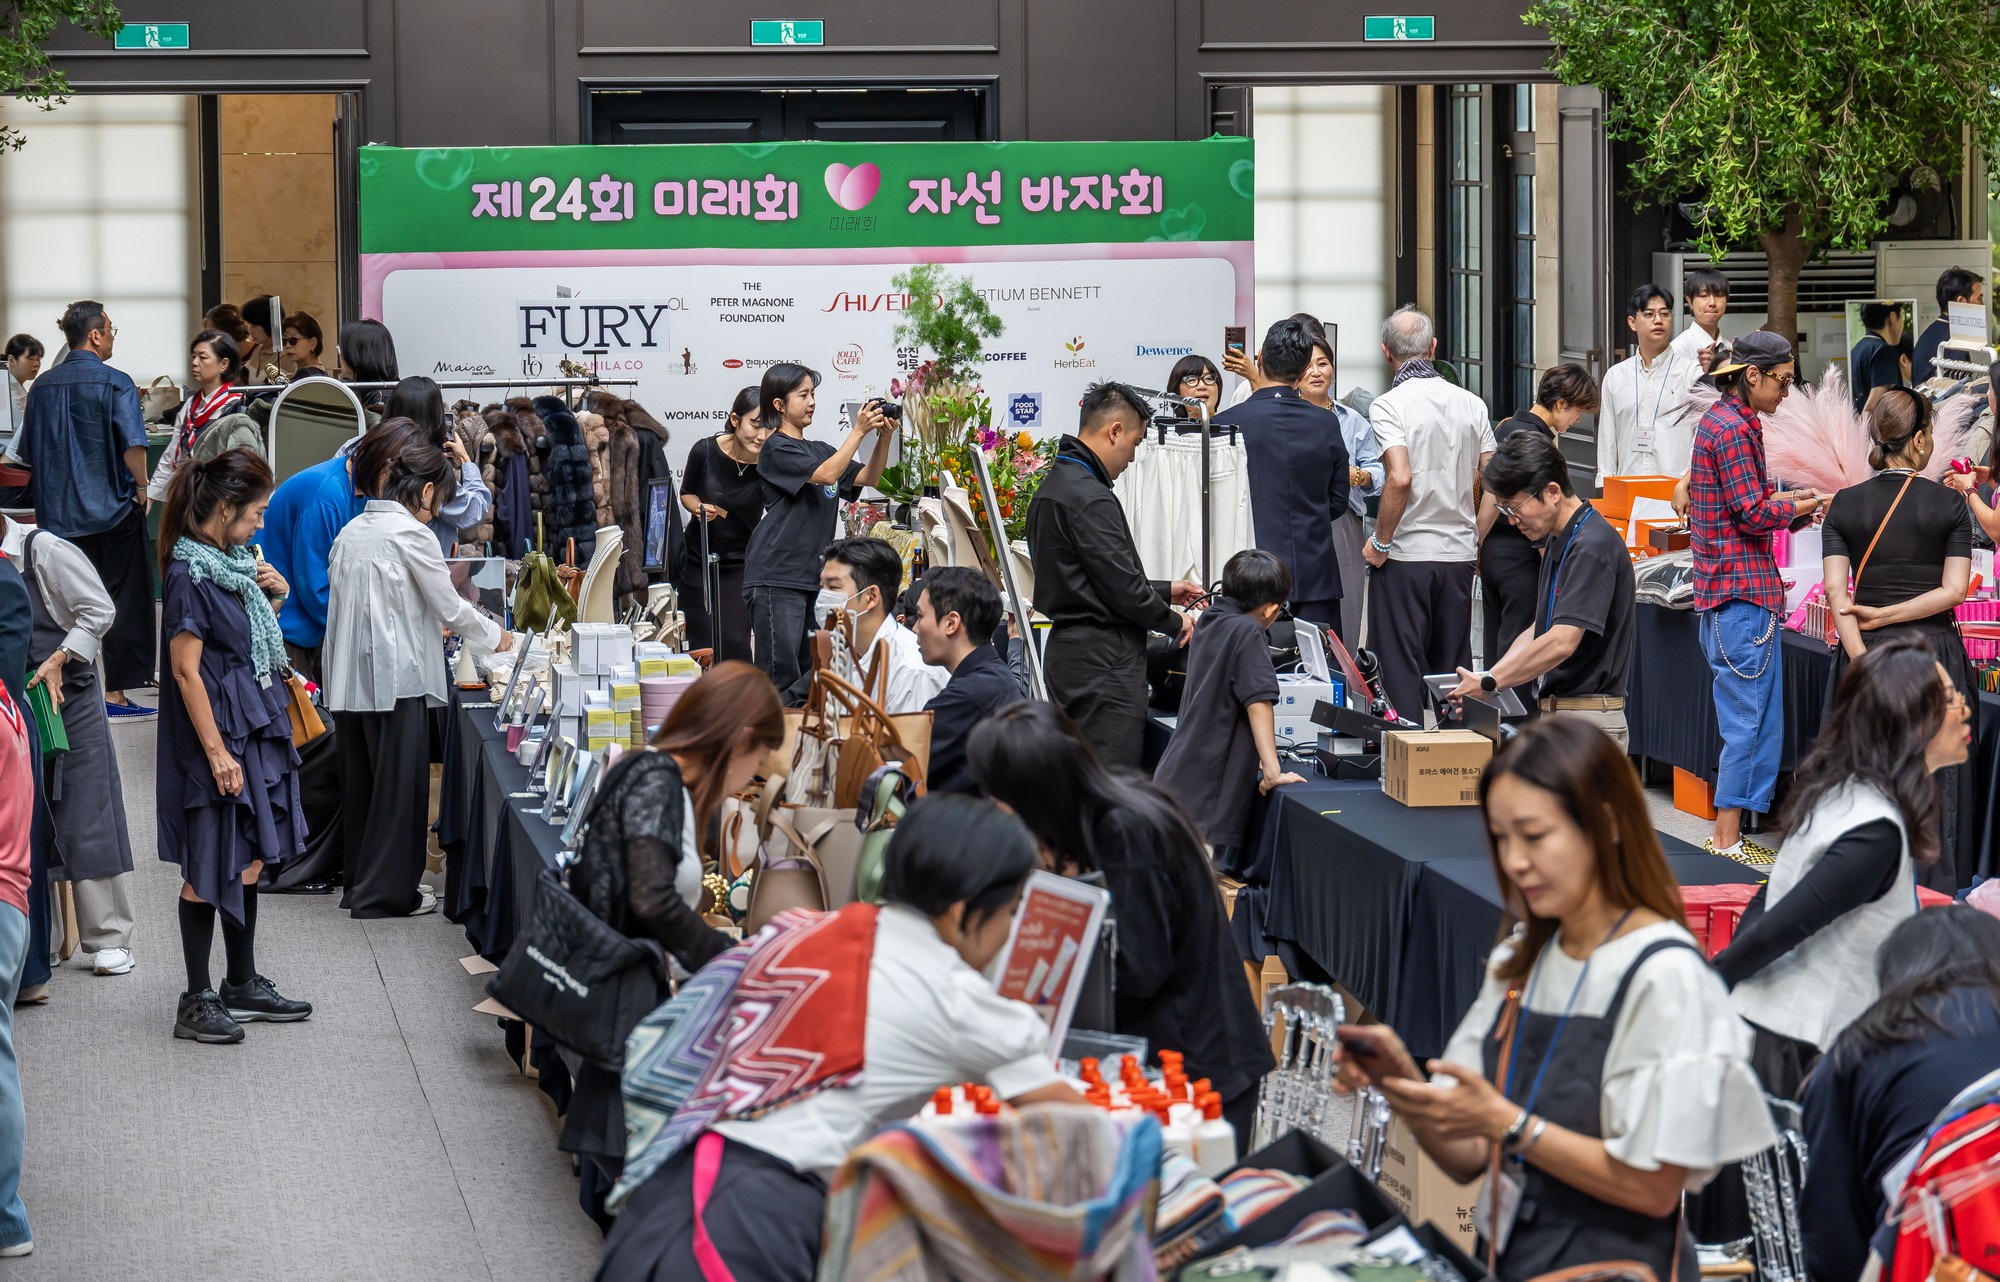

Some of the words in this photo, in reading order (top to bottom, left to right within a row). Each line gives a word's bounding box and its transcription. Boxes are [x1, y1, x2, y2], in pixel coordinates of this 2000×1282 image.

[471, 173, 634, 221] 제24회
[653, 173, 798, 221] 미래회
[908, 170, 1001, 224] 자선
[1021, 167, 1163, 214] 바자회
[829, 215, 877, 231] 미래회
[742, 282, 762, 291] THE
[1029, 285, 1102, 301] BENNETT
[710, 297, 739, 307] PETER
[741, 297, 794, 307] MAGNONE
[820, 291, 944, 313] SHISEIO
[719, 313, 785, 323] FOUNDATION
[519, 305, 668, 348] FURY
[837, 350, 859, 359] JOLLY
[896, 346, 919, 358] 삼진
[984, 352, 1027, 362] COFFEE
[433, 361, 496, 375] Maison
[577, 361, 621, 371] ANILA
[624, 360, 643, 370] CO
[896, 359, 919, 371] 어묵
[1054, 358, 1096, 369] HerbEat
[664, 411, 709, 420] WOMAN
[712, 411, 731, 420] SEN
[1418, 768, 1438, 776] 조아스
[1439, 767, 1459, 776] 에어건
[1461, 767, 1481, 776] 청소기
